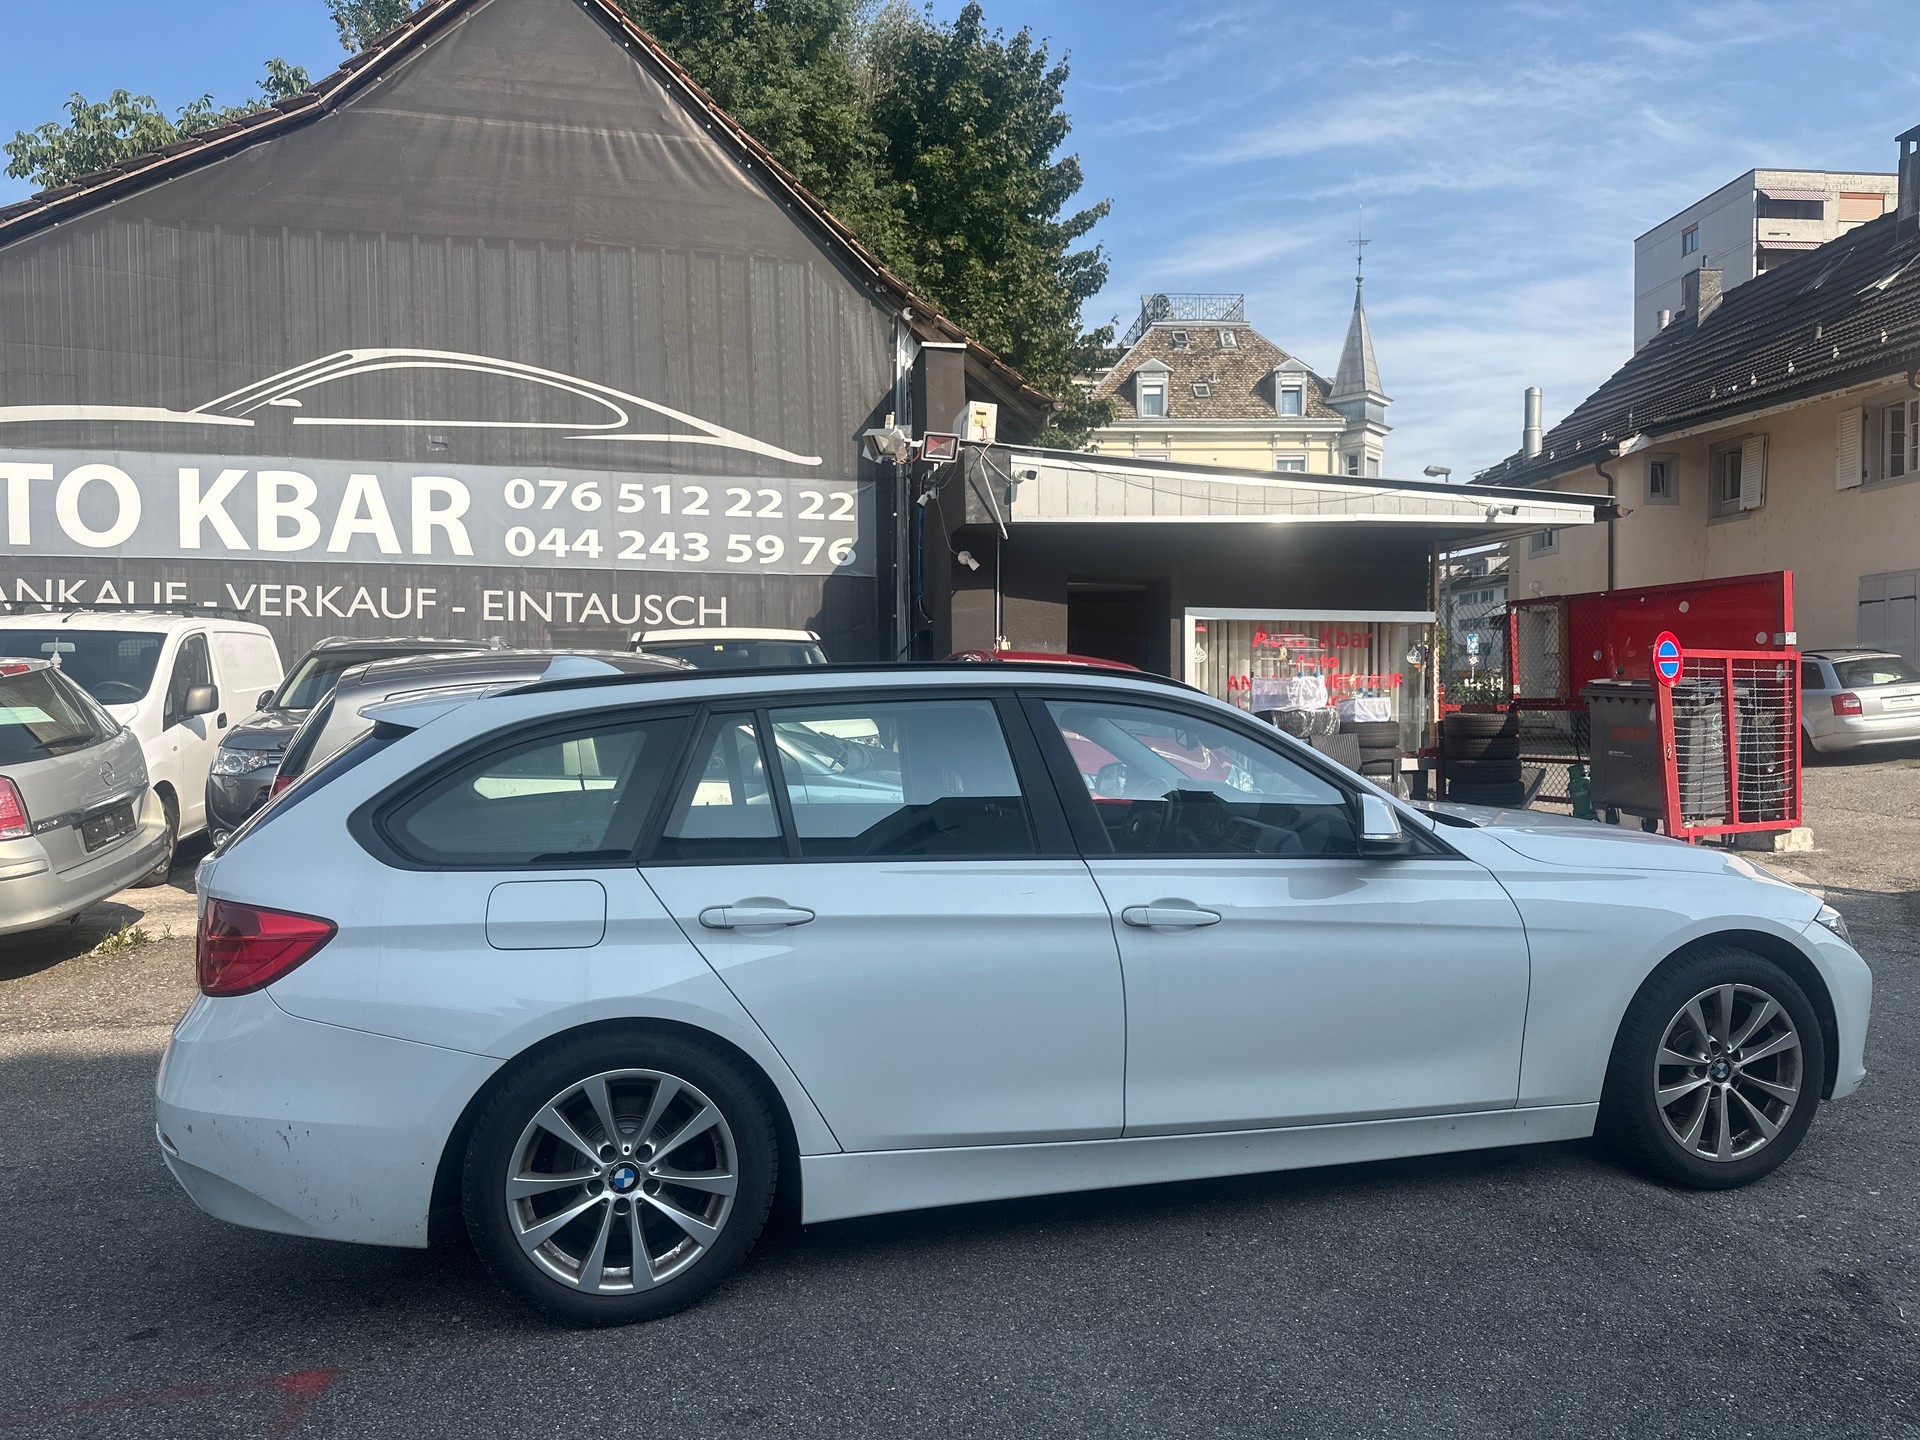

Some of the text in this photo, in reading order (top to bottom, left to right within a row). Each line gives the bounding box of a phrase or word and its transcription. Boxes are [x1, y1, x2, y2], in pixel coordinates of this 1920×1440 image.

[178, 467, 475, 556] KBAR
[503, 478, 855, 522] 076 512 22 22
[504, 525, 857, 567] 044 243 59 76
[225, 583, 437, 620] VERKAUF
[482, 588, 728, 627] EINTAUSCH
[1253, 624, 1373, 649] Auto Kbar
[1295, 653, 1339, 669] Auto
